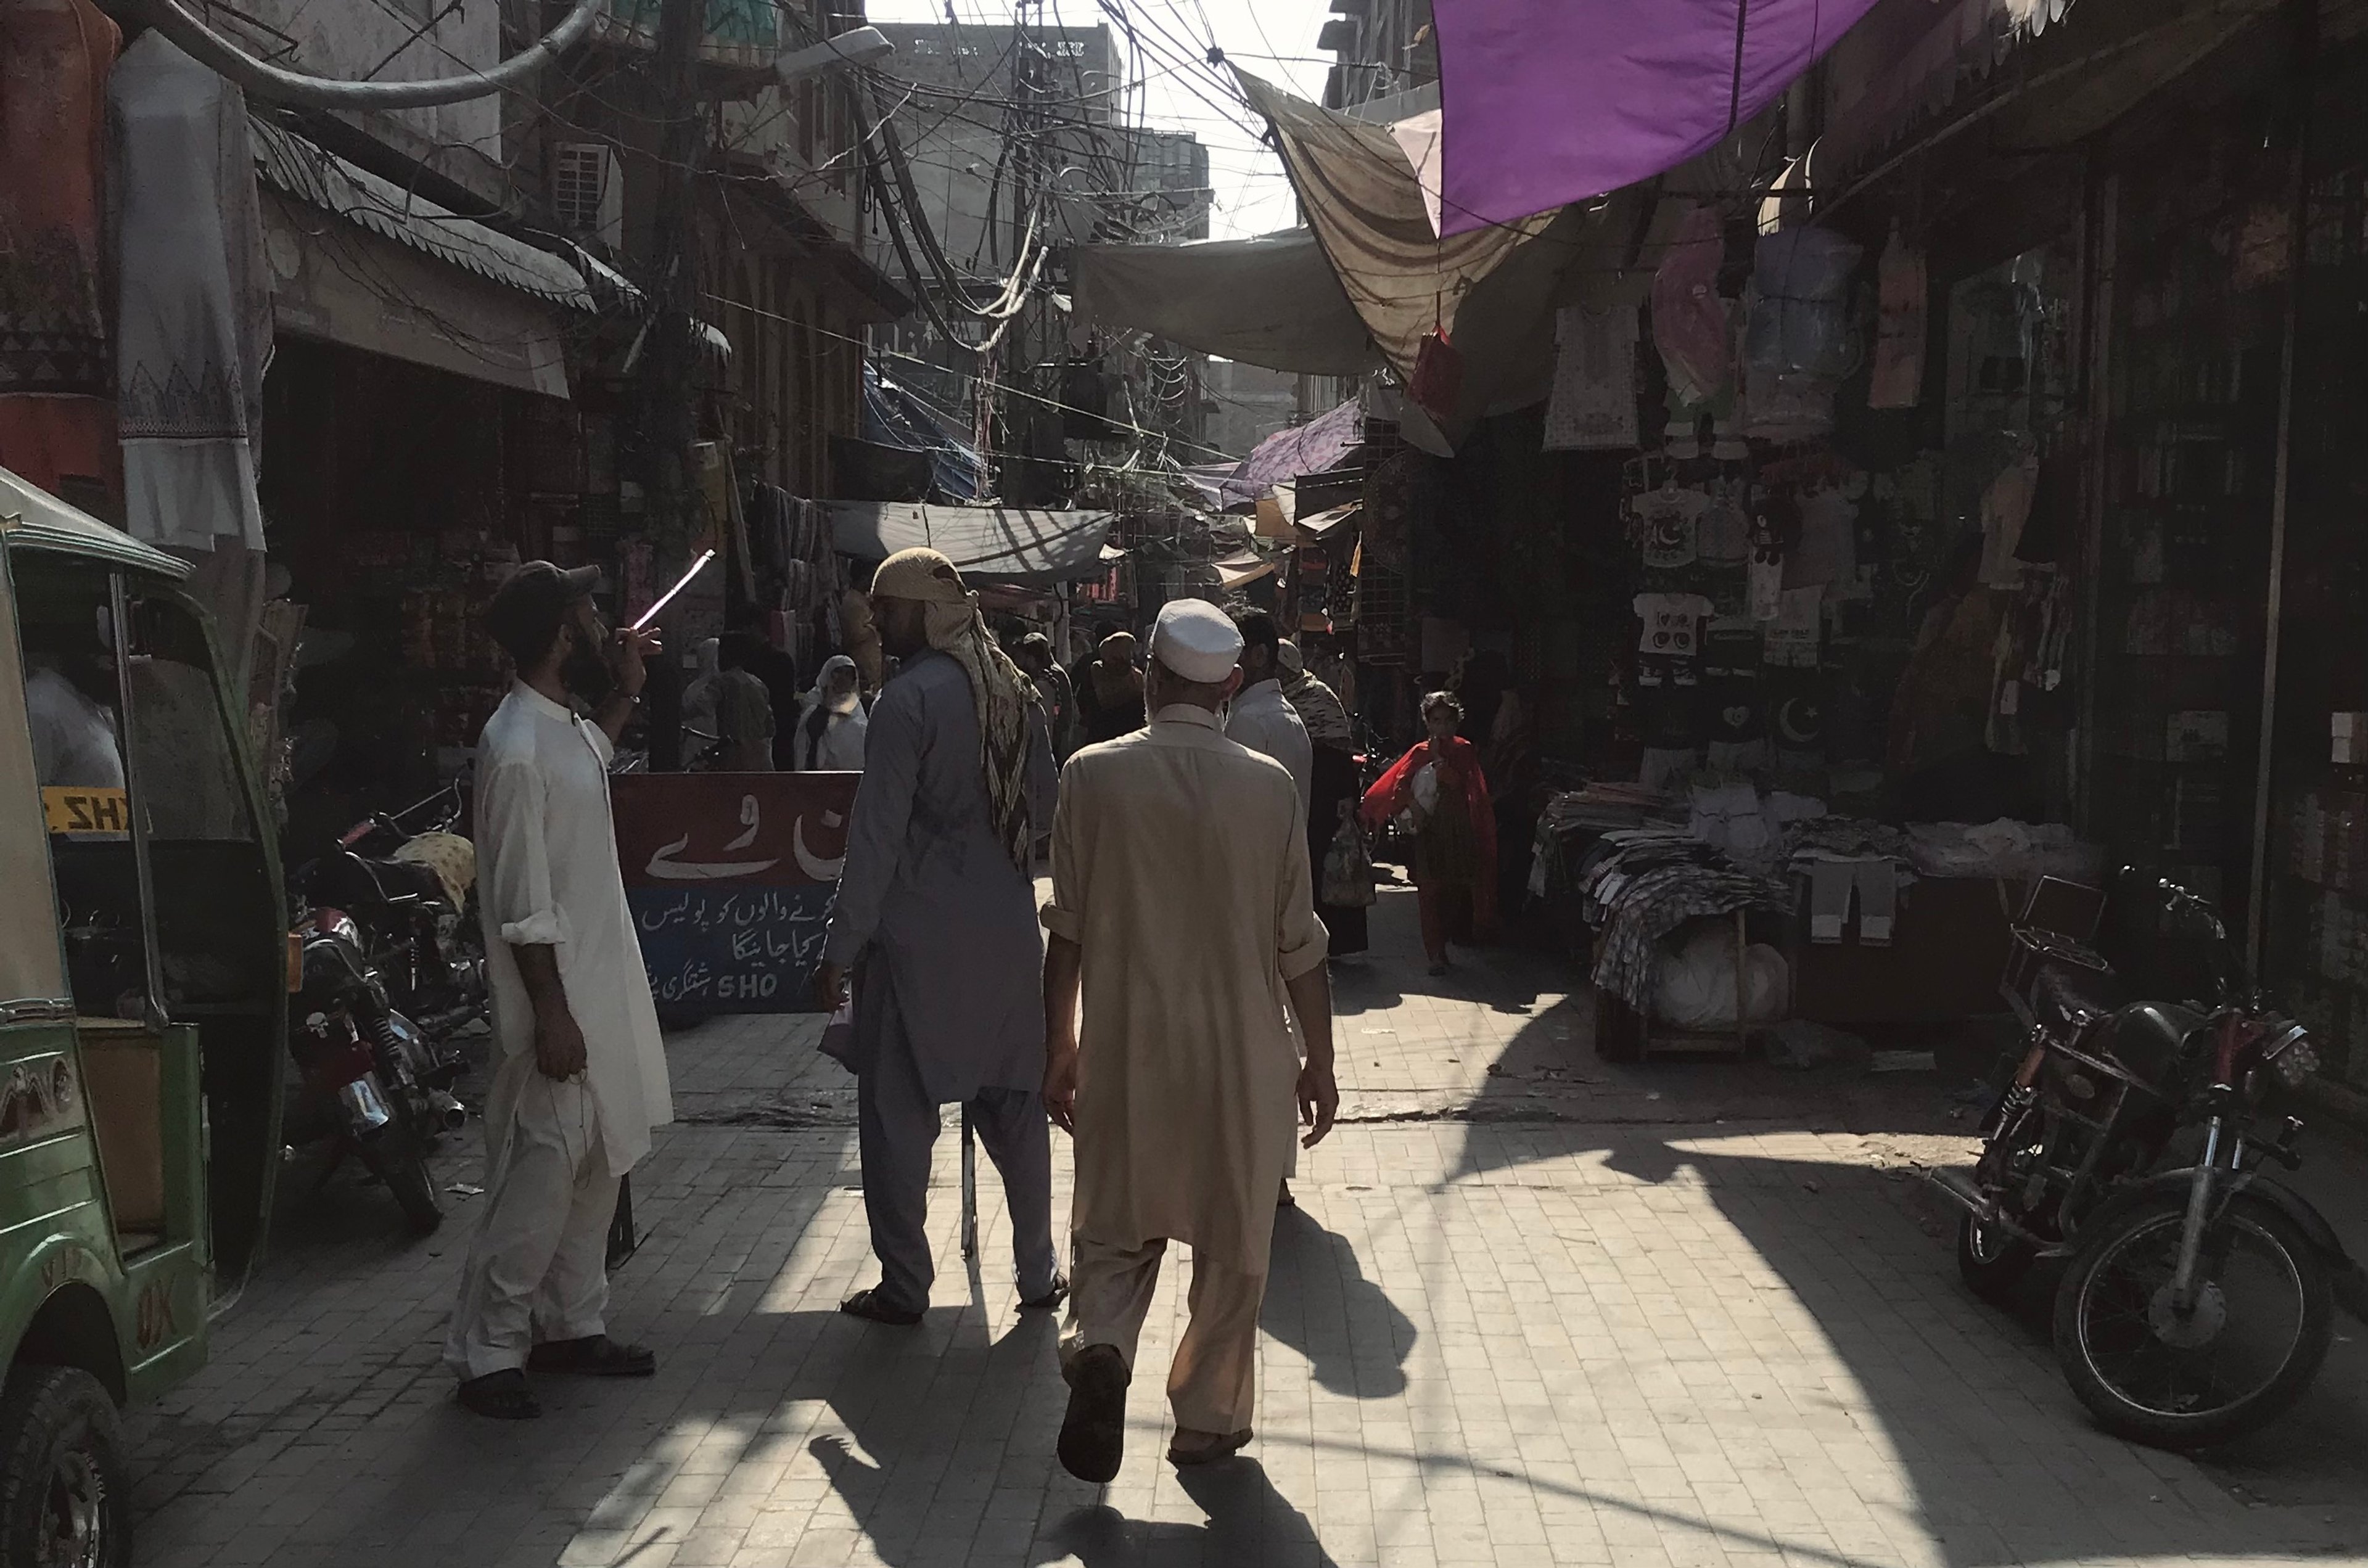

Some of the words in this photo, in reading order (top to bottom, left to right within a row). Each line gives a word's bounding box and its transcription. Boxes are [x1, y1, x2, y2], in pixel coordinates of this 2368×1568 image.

[642, 892, 709, 932] پولیس
[716, 893, 739, 924] کو
[717, 973, 777, 999] SHO
